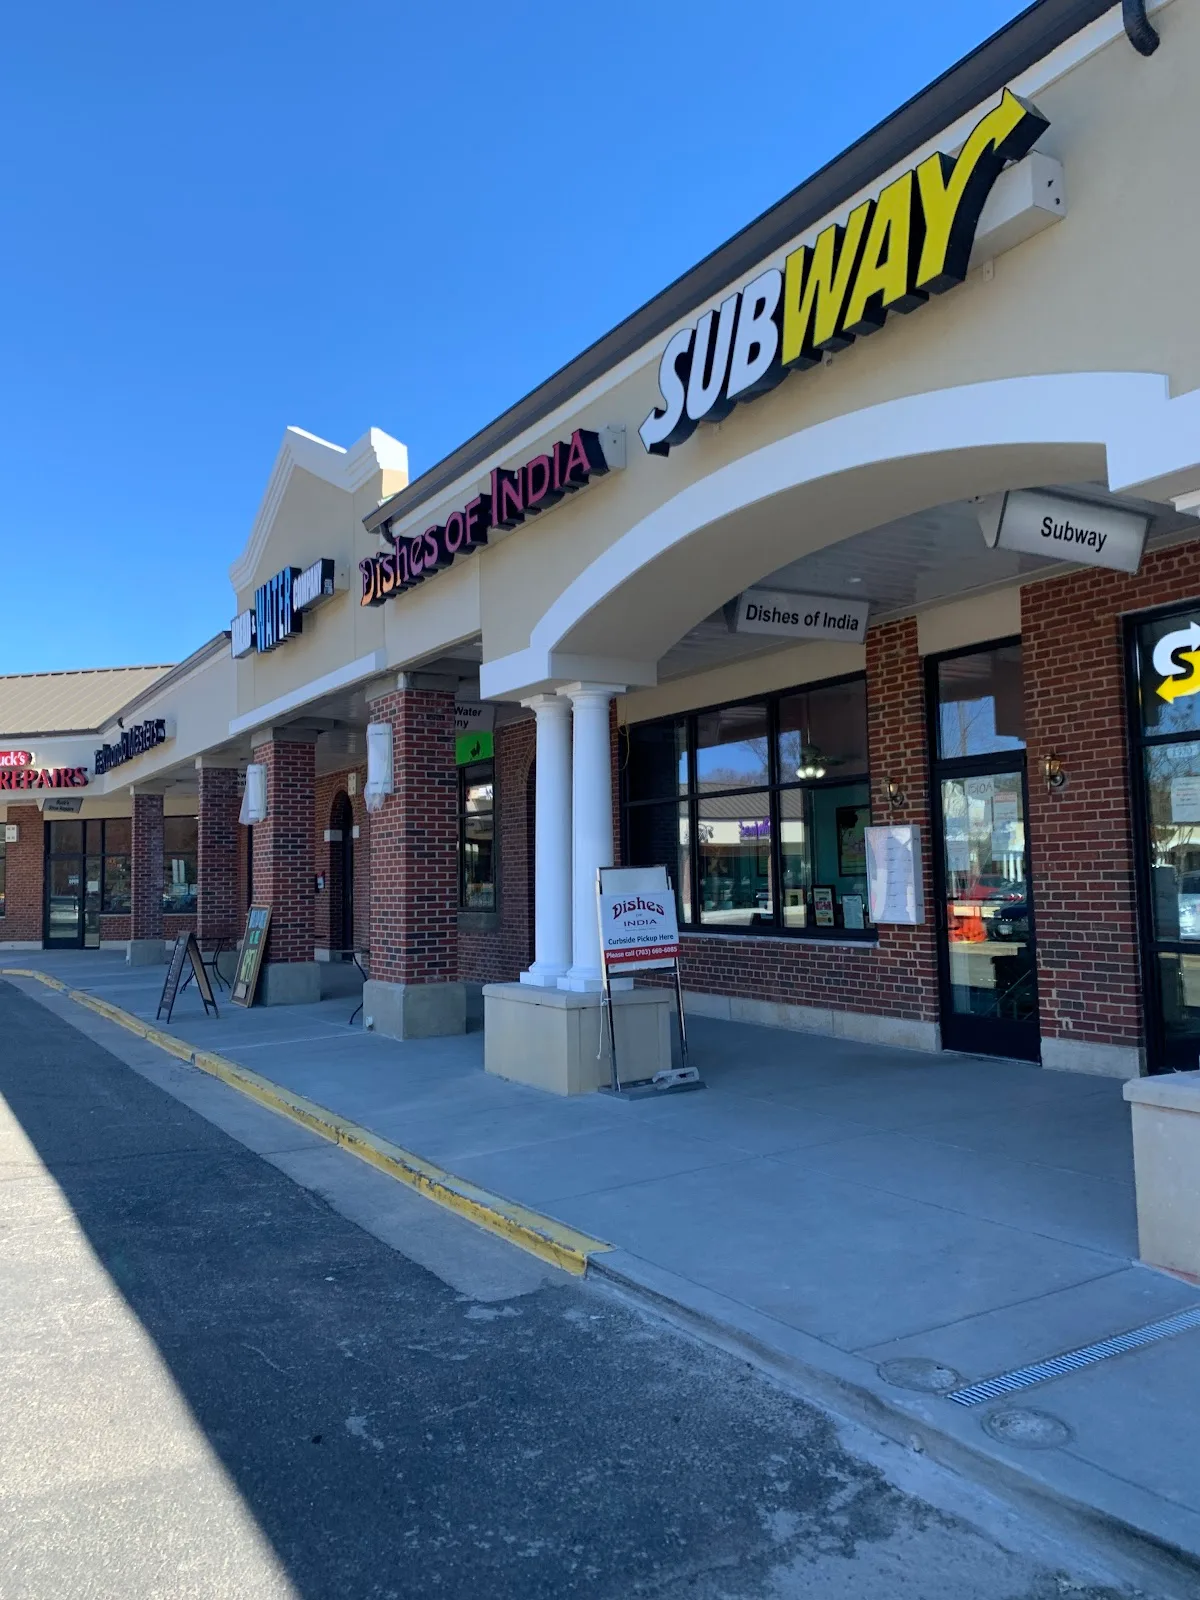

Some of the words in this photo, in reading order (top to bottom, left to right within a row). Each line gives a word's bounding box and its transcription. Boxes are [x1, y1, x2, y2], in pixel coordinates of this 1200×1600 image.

[638, 87, 1029, 454] SUBWAY
[490, 429, 592, 528] INDIA
[1041, 516, 1107, 553] Subway
[255, 566, 291, 654] WATER
[745, 604, 799, 625] Dishes
[804, 611, 820, 626] of
[823, 612, 859, 631] India
[454, 705, 482, 717] Water
[0, 767, 89, 790] REPAIRS
[612, 896, 664, 919] Dishes
[623, 919, 657, 927] INDIA
[608, 936, 635, 945] Curbside
[637, 935, 658, 943] Pickup
[606, 951, 624, 959] Please
[635, 948, 651, 957] (703)
